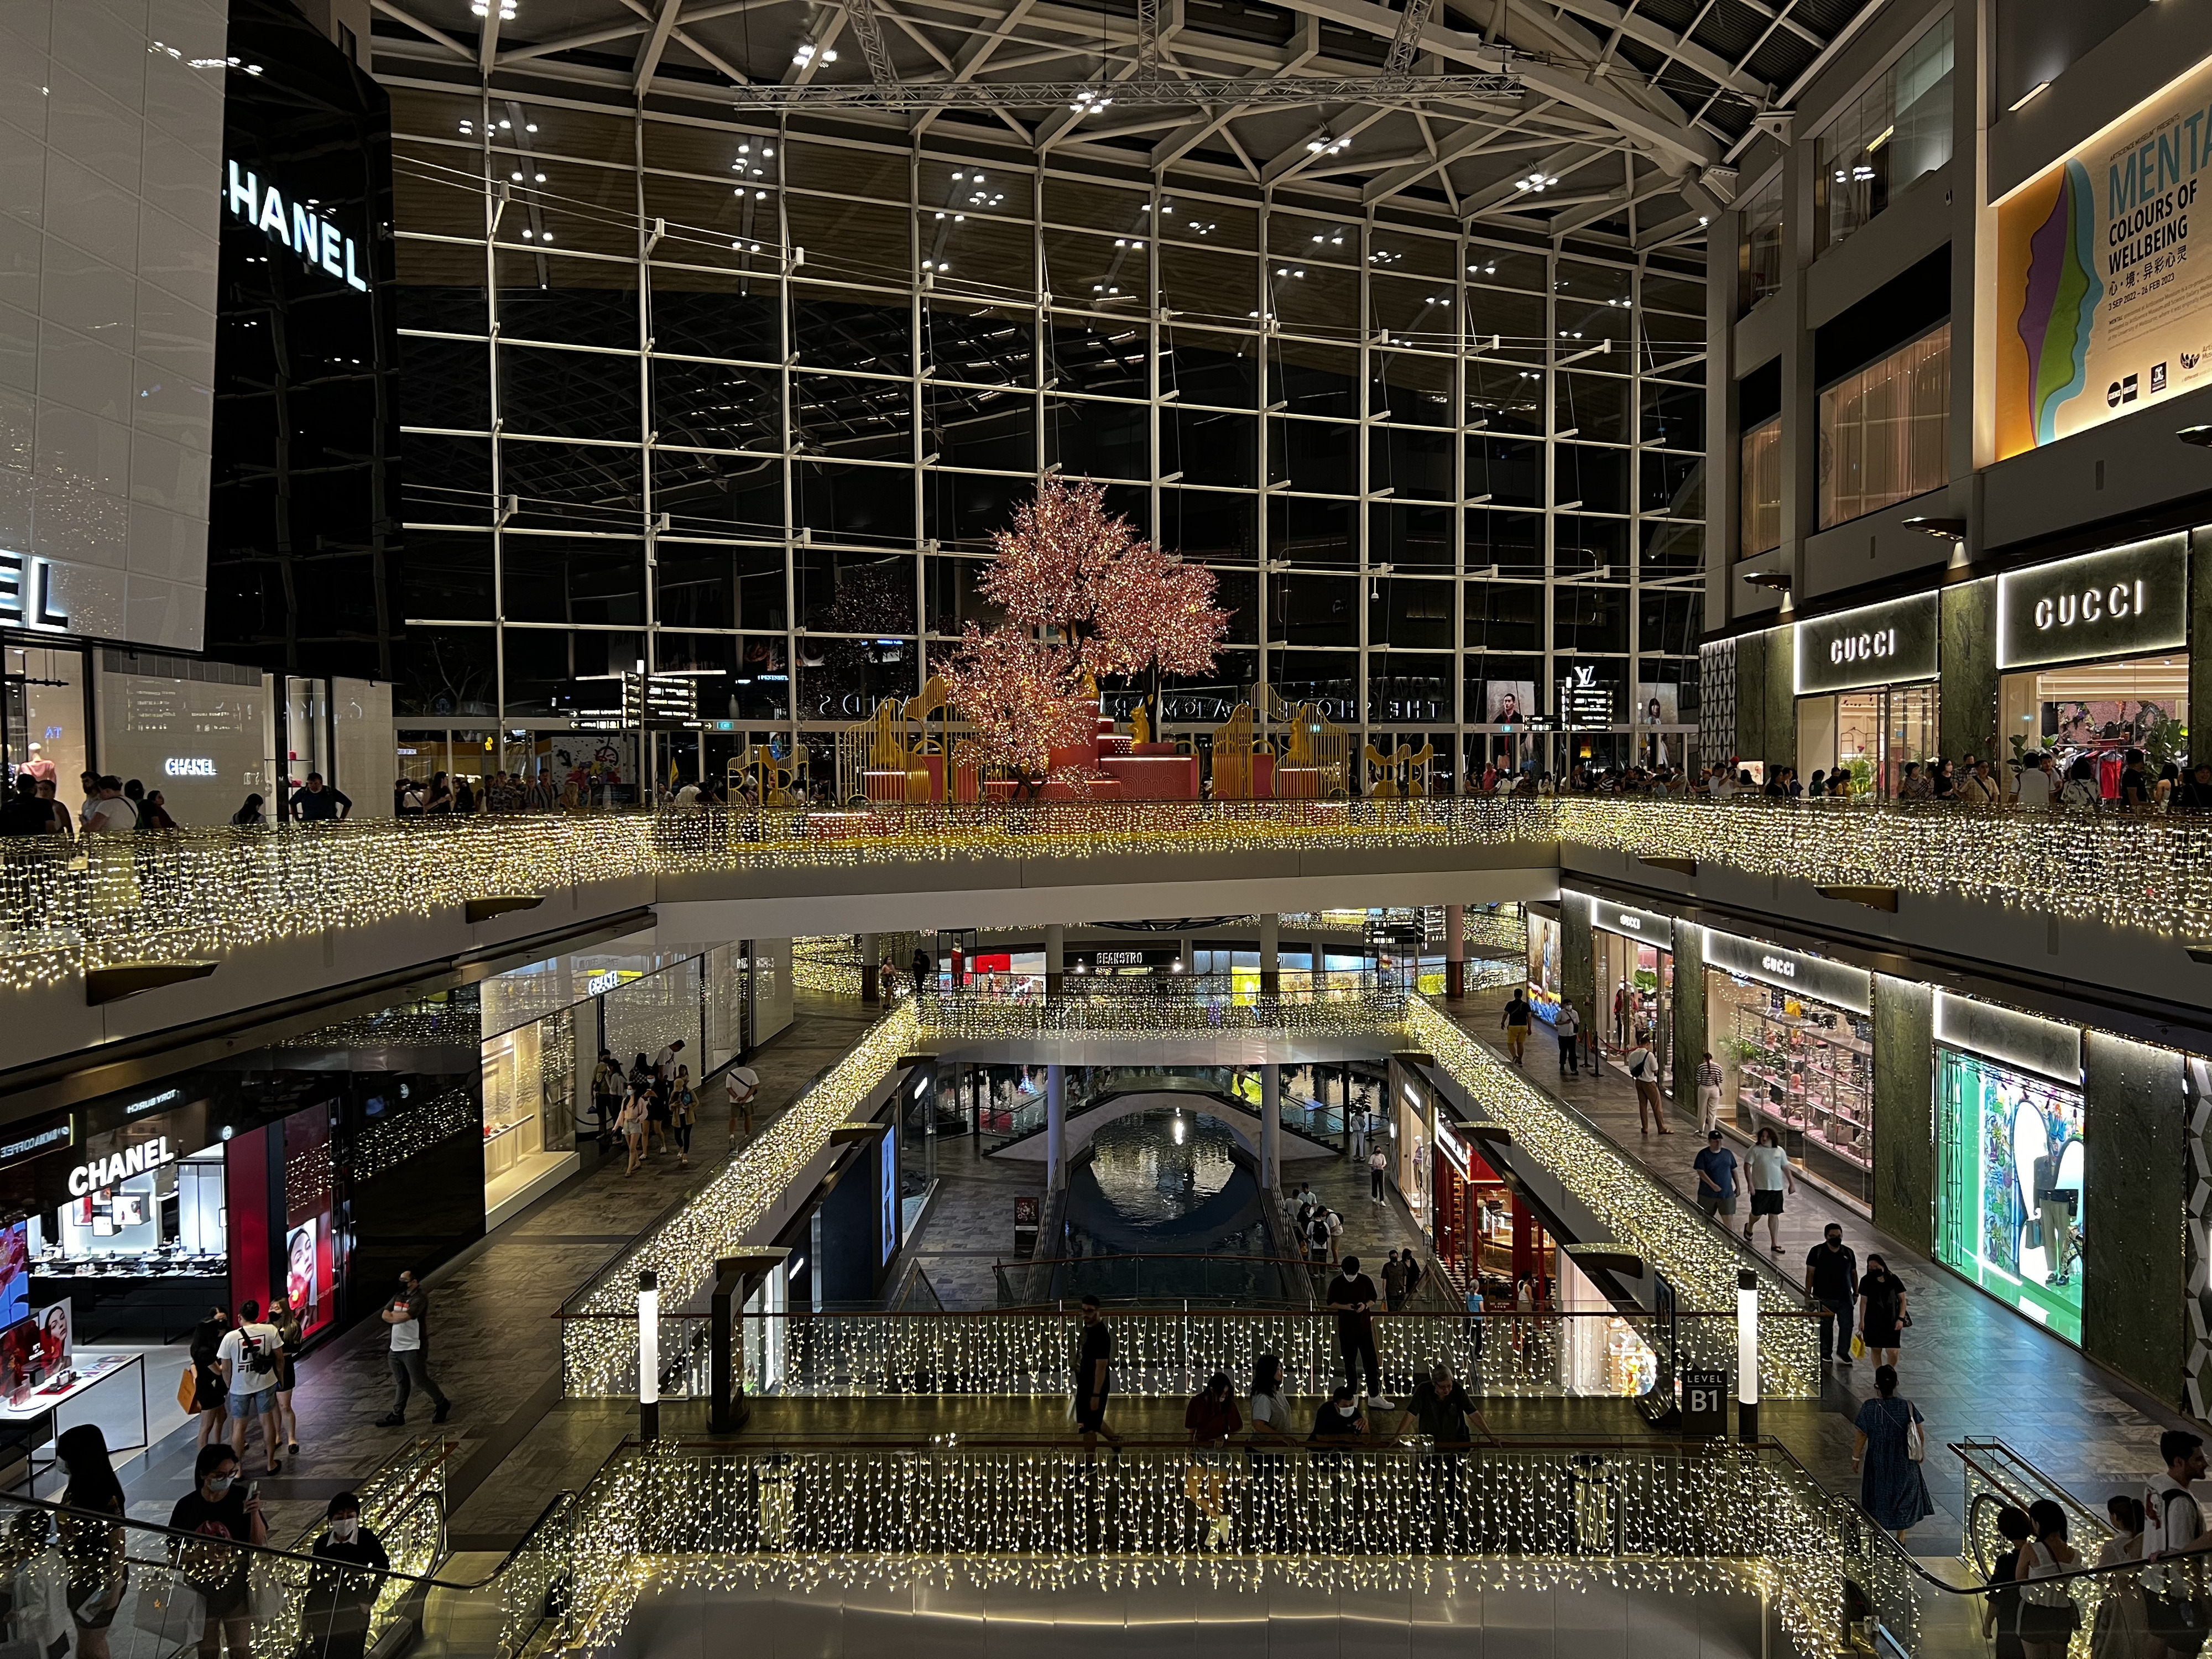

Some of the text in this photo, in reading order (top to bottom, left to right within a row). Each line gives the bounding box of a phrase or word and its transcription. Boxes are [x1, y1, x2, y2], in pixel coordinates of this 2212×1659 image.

[2157, 113, 2180, 133] PRESENTS
[225, 160, 366, 292] HANEL
[2109, 178, 2197, 247] COLOURS OF
[2109, 215, 2188, 276] WELLBEING
[2112, 298, 2123, 309] SEP
[2124, 291, 2136, 304] 2022
[2141, 286, 2148, 295] 26
[2149, 280, 2161, 292] FEB
[2161, 273, 2175, 286] 2023
[2034, 579, 2143, 631] GUCCI
[1829, 629, 1895, 664] GUCCI
[165, 758, 217, 775] CHANEL
[1619, 914, 1641, 930] GUCCI
[1096, 952, 1142, 964] BEANSTRO
[1762, 956, 1795, 977] GUCCI
[68, 1135, 174, 1197] CHANEL
[1687, 1375, 1722, 1383] LEVEL
[1692, 1389, 1717, 1412] B1
